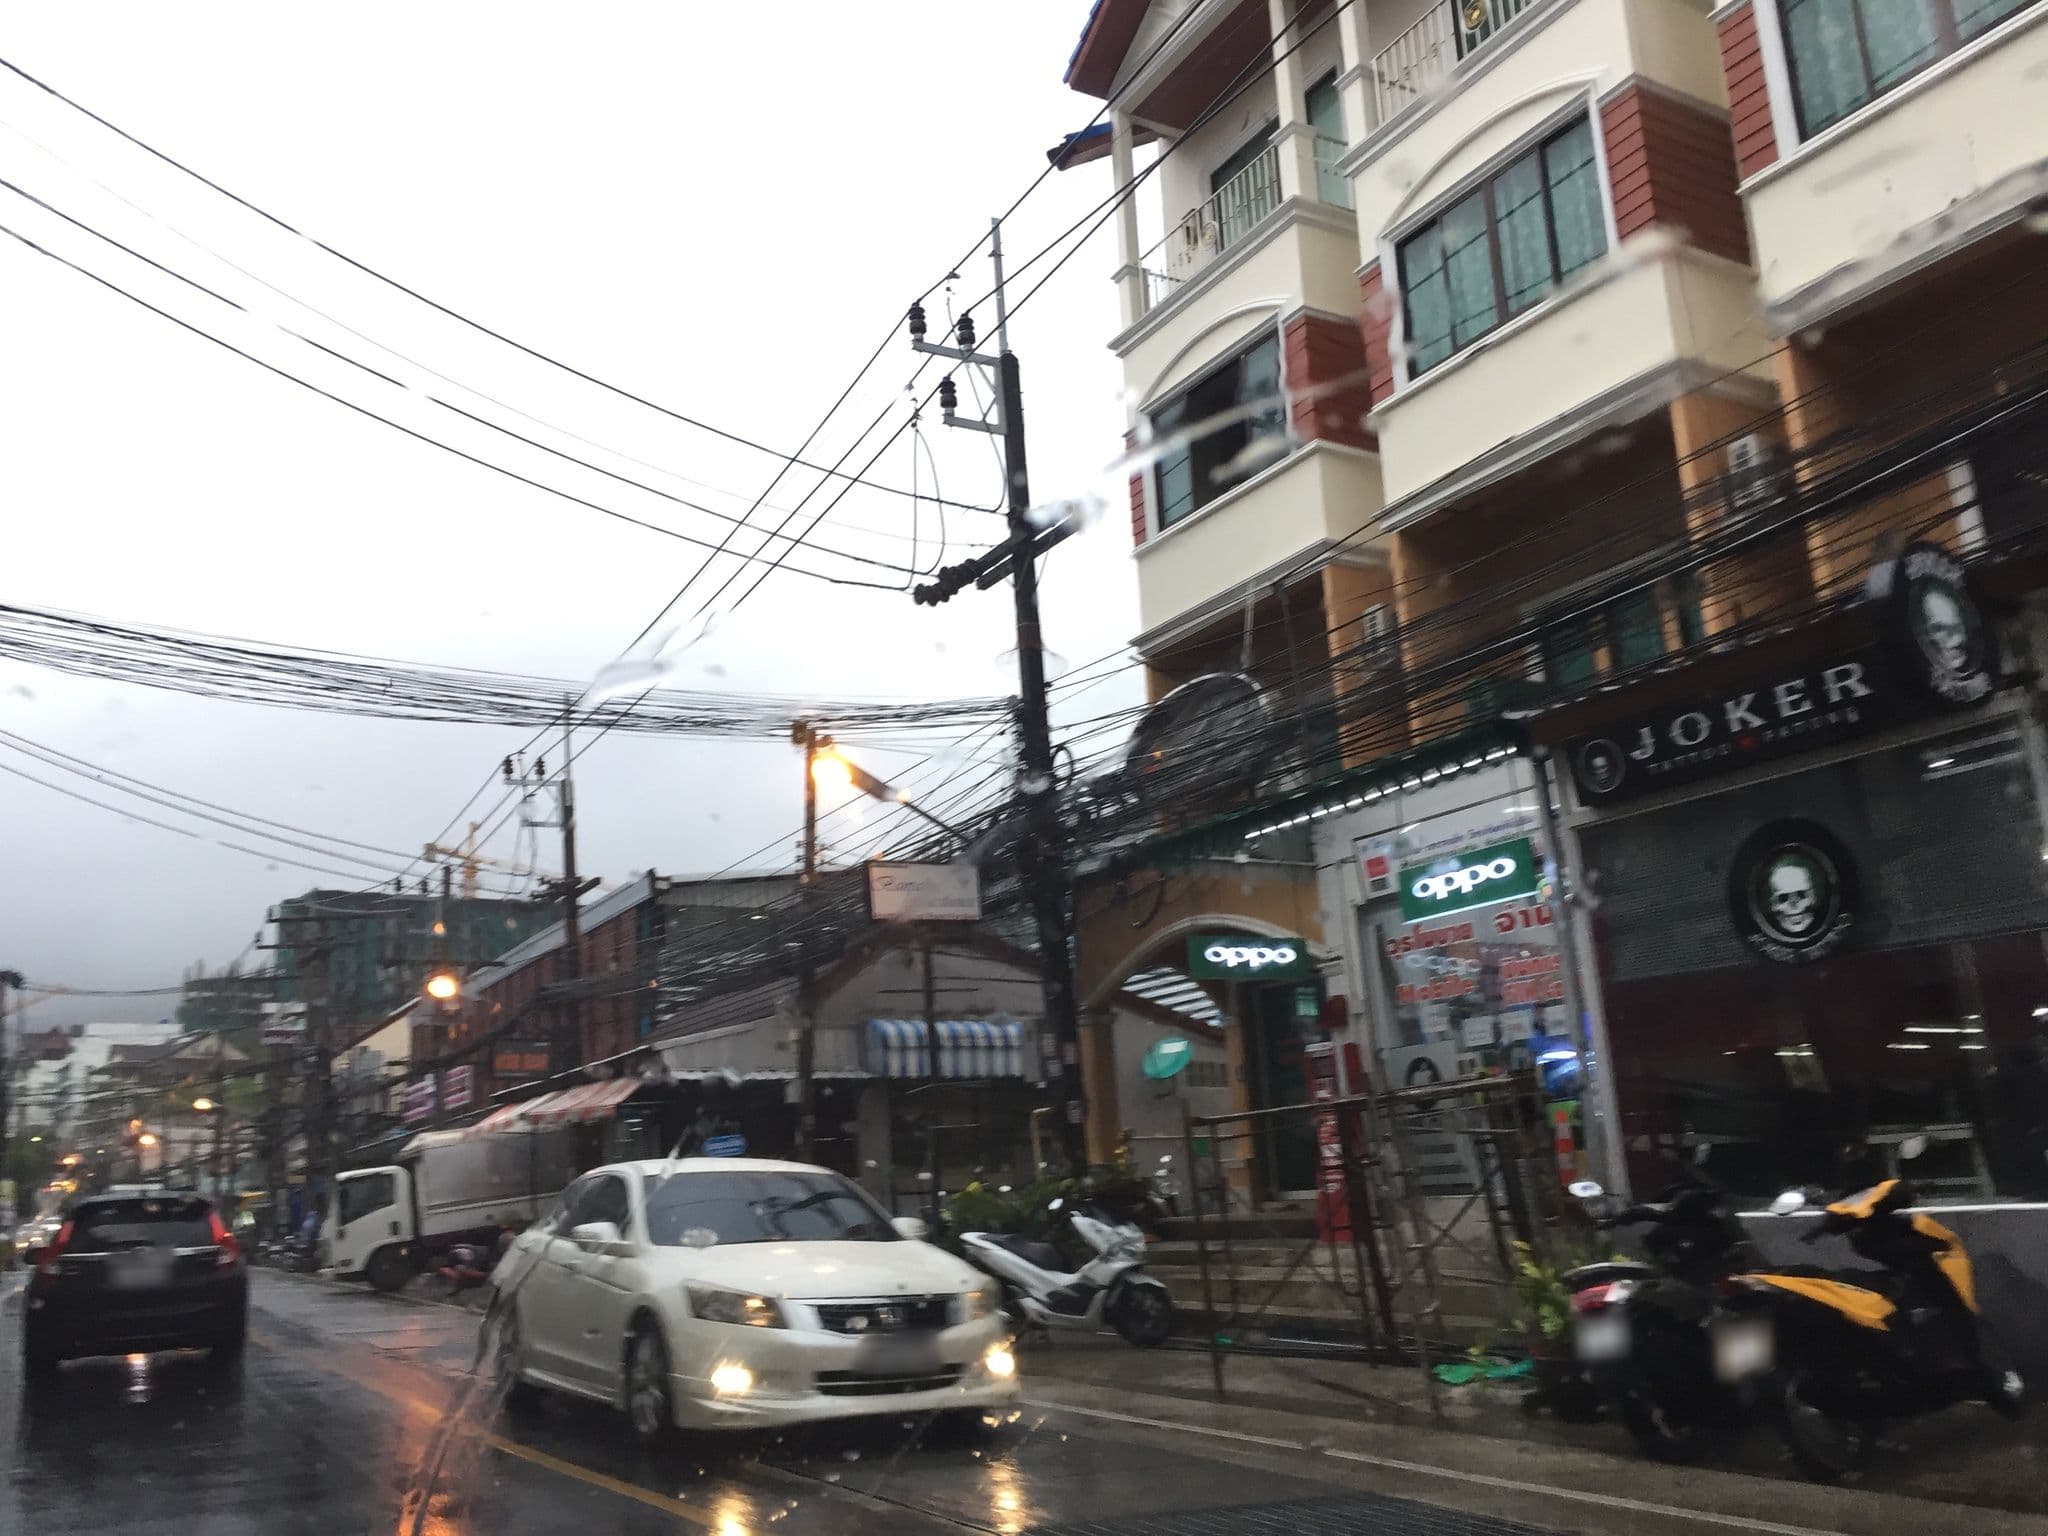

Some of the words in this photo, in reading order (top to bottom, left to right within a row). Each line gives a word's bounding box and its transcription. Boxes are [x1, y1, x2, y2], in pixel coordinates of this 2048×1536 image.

[1629, 662, 1874, 760] JOKER
[1412, 857, 1517, 900] oppo
[1203, 945, 1298, 968] oppo
